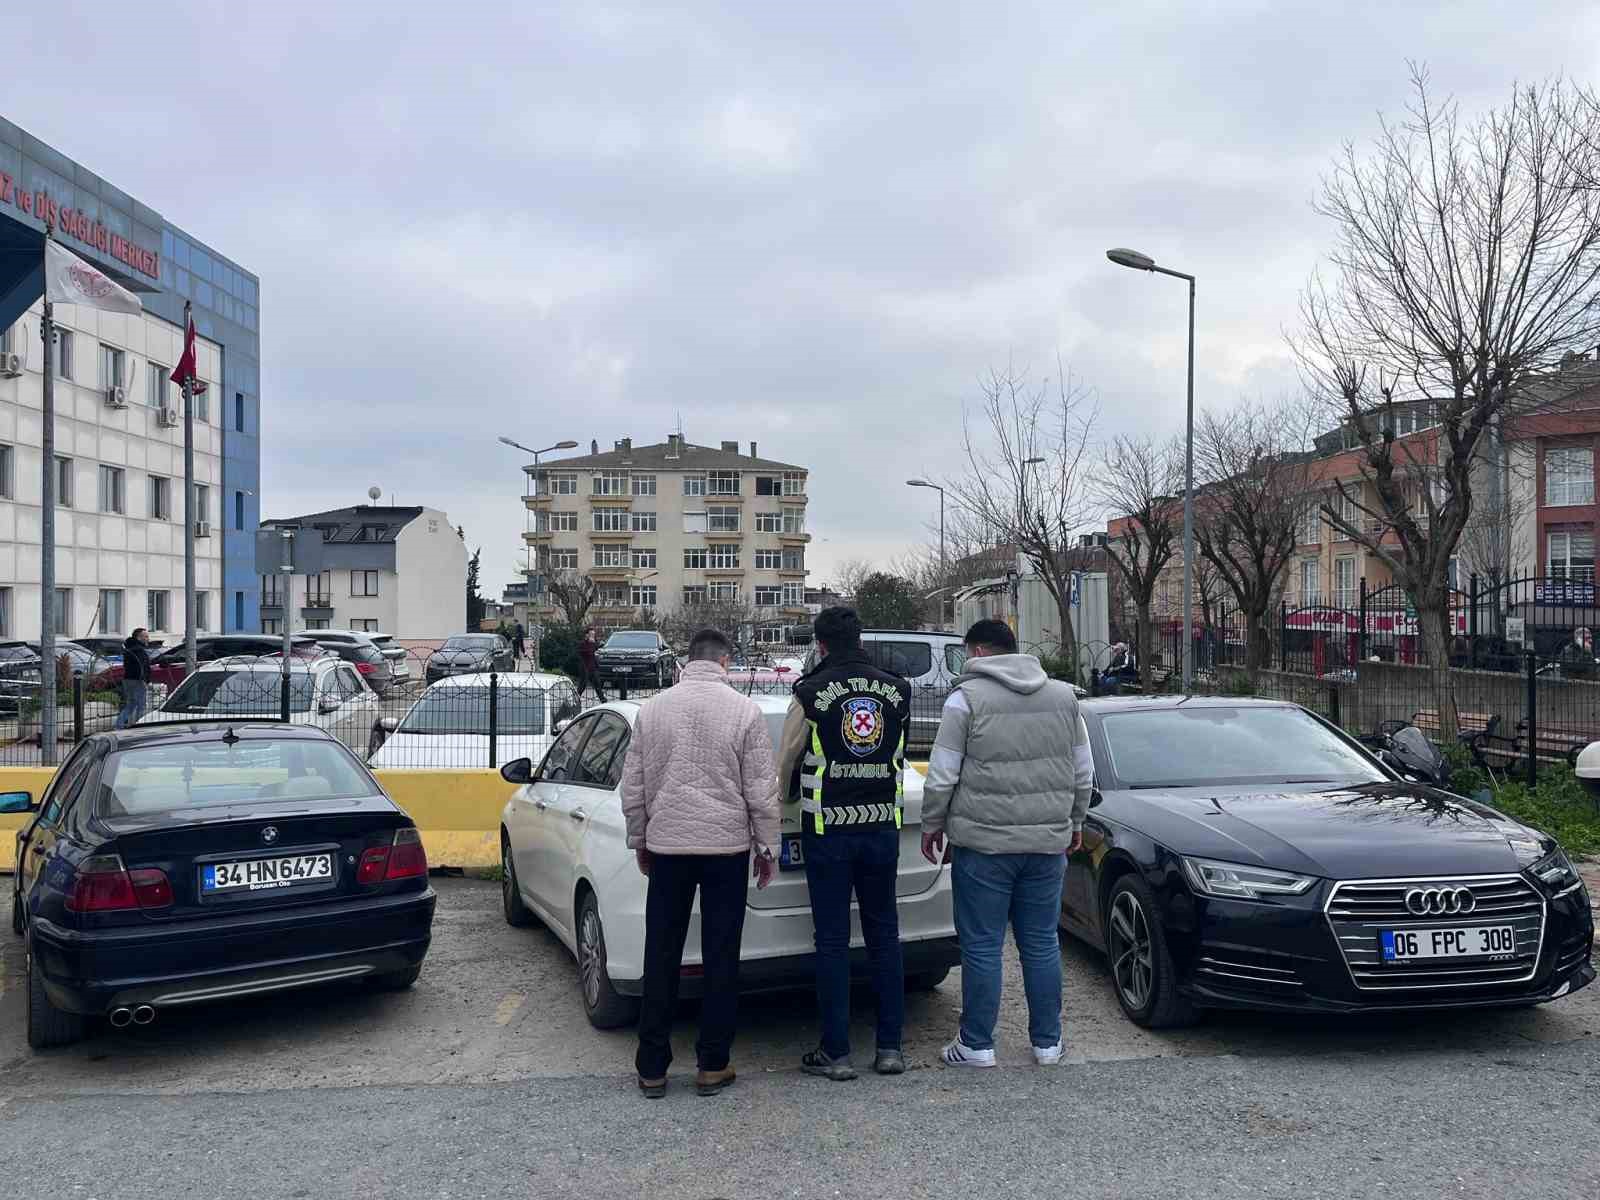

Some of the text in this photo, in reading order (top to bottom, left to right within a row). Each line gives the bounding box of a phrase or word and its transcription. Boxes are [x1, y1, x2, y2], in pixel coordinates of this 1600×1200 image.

[16, 188, 32, 213] ve
[814, 680, 849, 712] SİVİL
[848, 677, 903, 708] TRAFİK
[829, 761, 890, 778] İSTANBUL
[216, 856, 330, 886] 34 HN 6473
[1394, 928, 1513, 955] 06 FPC 308
